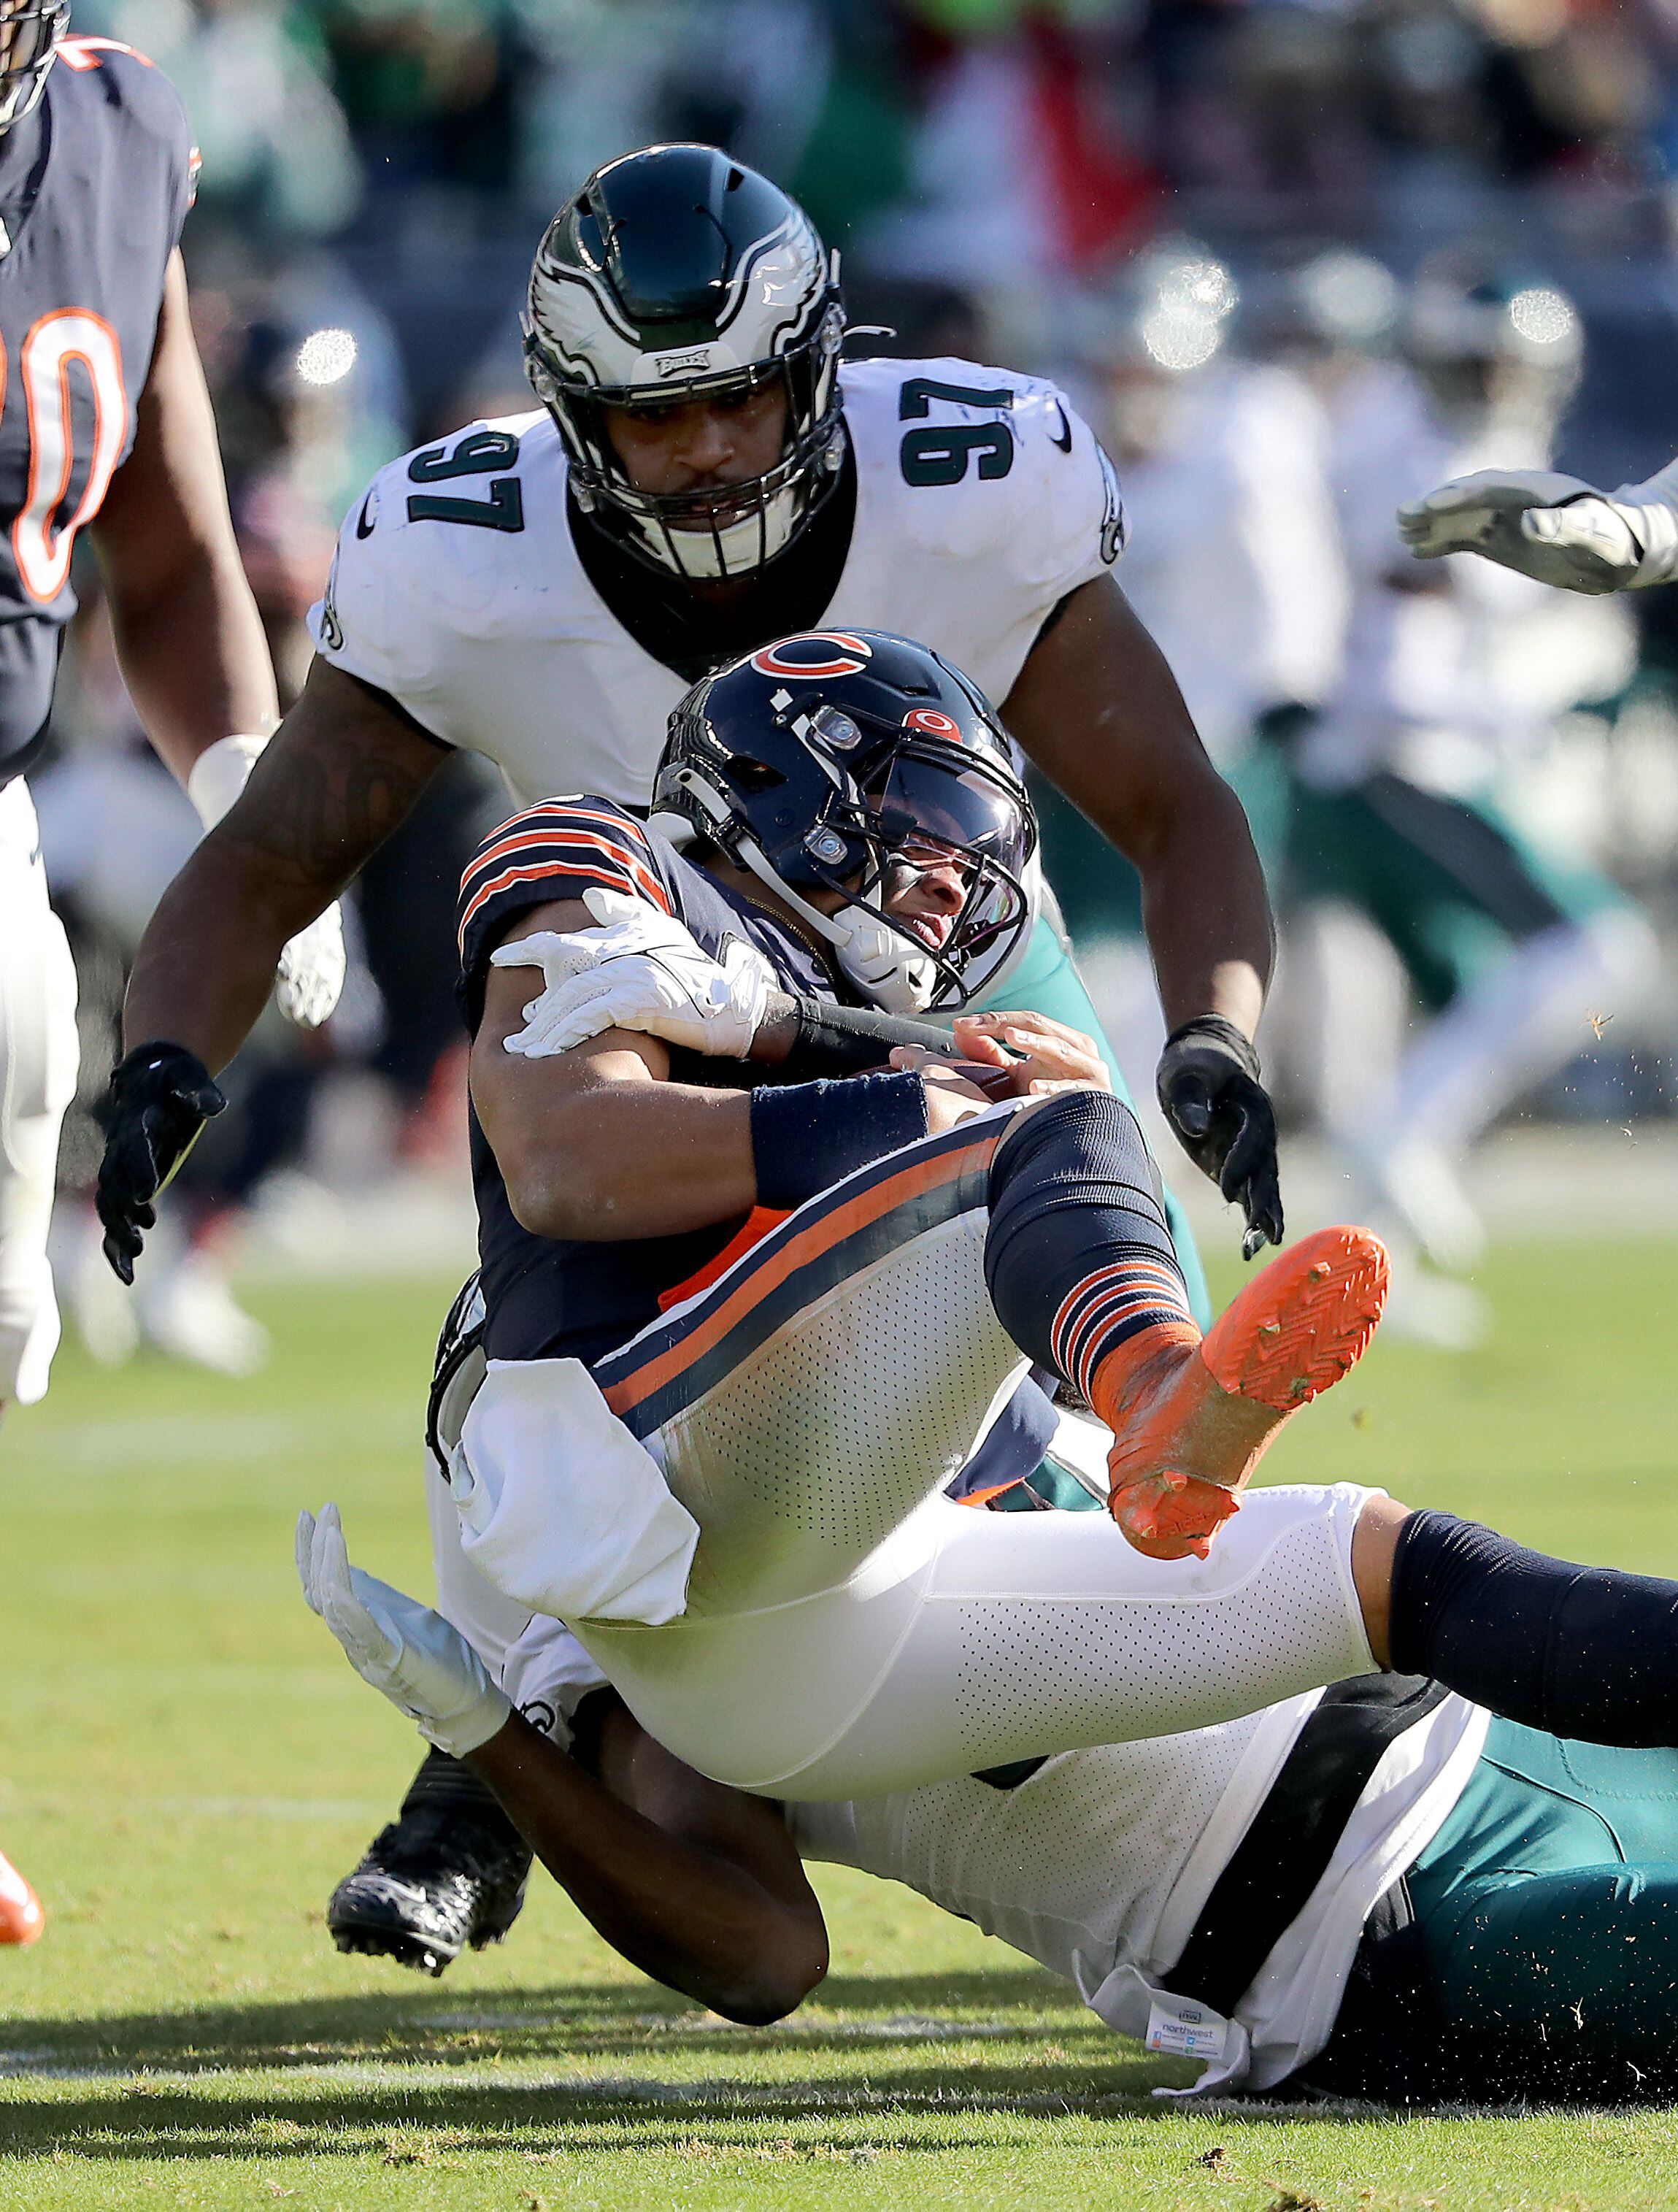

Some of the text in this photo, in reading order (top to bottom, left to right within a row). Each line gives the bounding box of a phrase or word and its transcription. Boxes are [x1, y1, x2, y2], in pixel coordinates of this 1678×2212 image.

[0, 306, 128, 604] 0
[407, 430, 526, 533] 97
[898, 377, 1014, 487] 97
[1163, 2024, 1213, 2039] northwest
